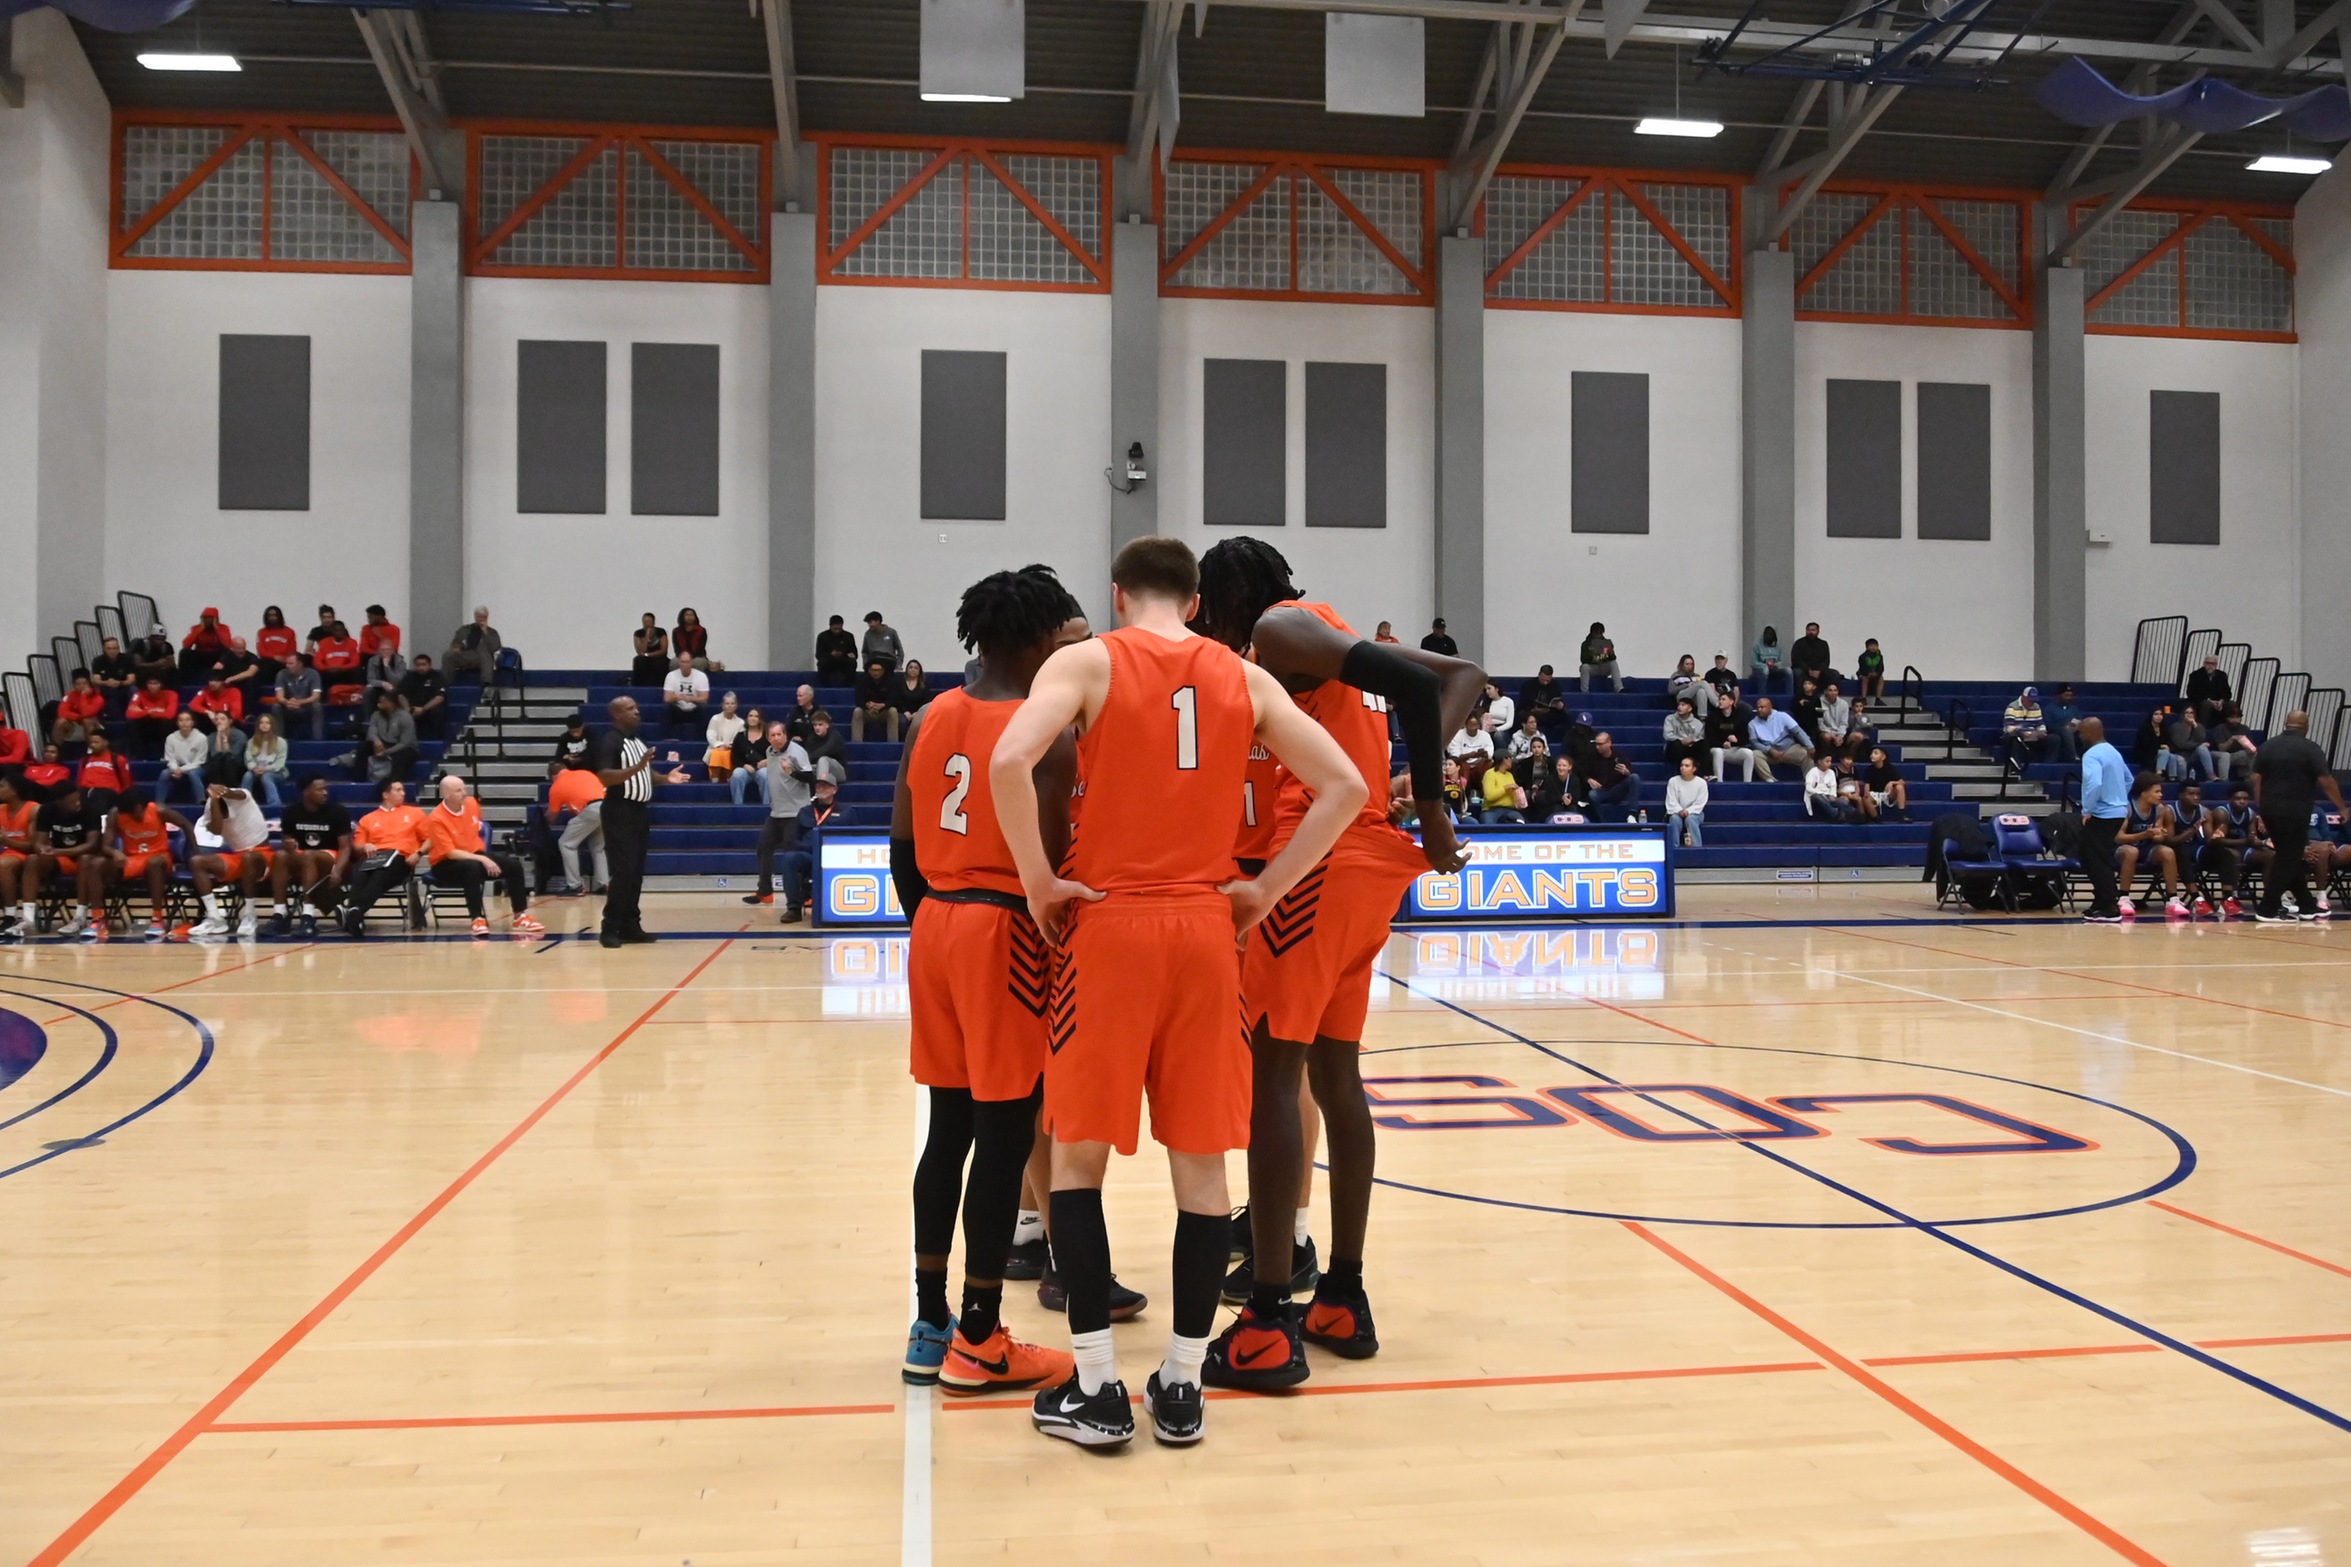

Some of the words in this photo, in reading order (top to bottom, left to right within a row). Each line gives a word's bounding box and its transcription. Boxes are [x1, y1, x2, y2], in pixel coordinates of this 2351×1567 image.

[1171, 686, 1198, 770] 1
[939, 752, 972, 837] 2
[1462, 845, 1522, 860] OME
[1535, 844, 1571, 860] OF
[1579, 844, 1633, 859] THE
[1418, 868, 1658, 910] GIANTS
